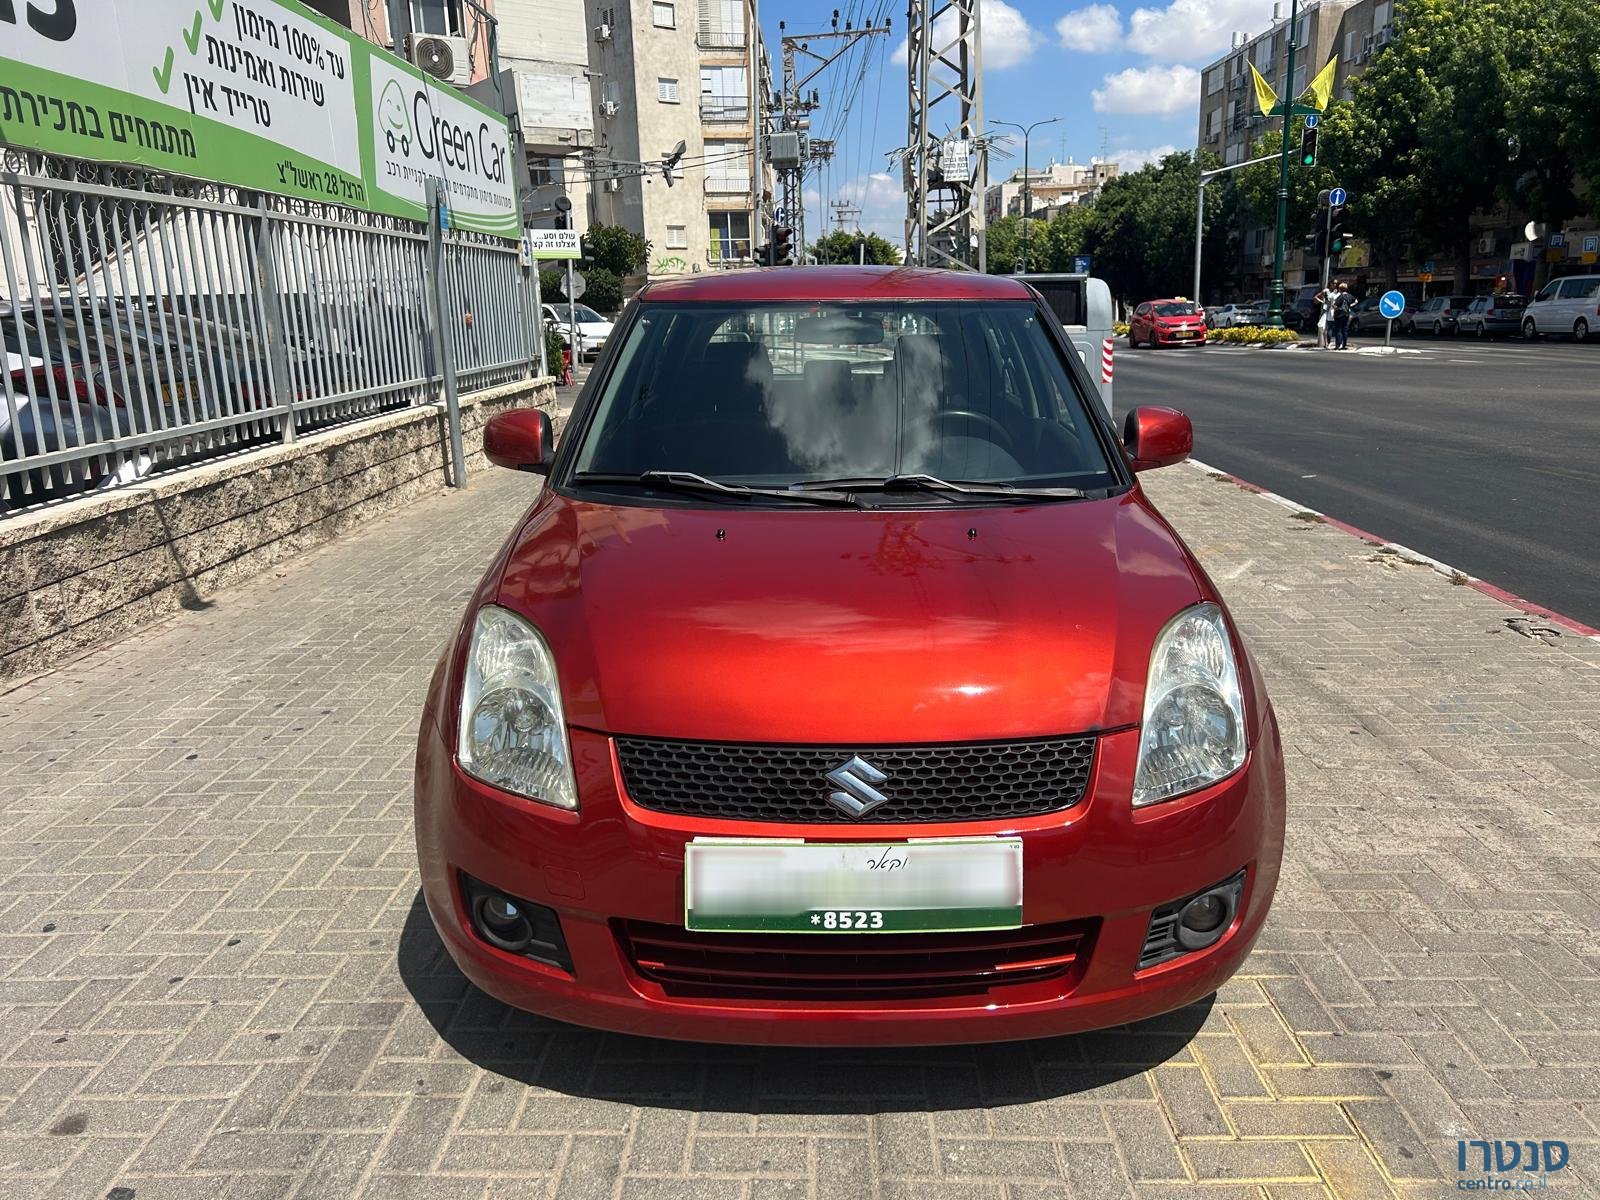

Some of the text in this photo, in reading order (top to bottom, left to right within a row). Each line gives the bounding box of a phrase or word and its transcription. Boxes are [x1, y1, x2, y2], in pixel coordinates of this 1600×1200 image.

[232, 2, 345, 80] עד 100% מימון
[205, 34, 325, 107] שירות ואמינות
[183, 72, 271, 128] טרייד אין
[107, 110, 197, 159] מתמחים
[413, 90, 506, 185] Green Car
[324, 171, 339, 196] 28
[338, 174, 365, 202] הרצל
[385, 160, 402, 178] רכב
[555, 240, 577, 248] אצלנו
[558, 231, 576, 240] שלם
